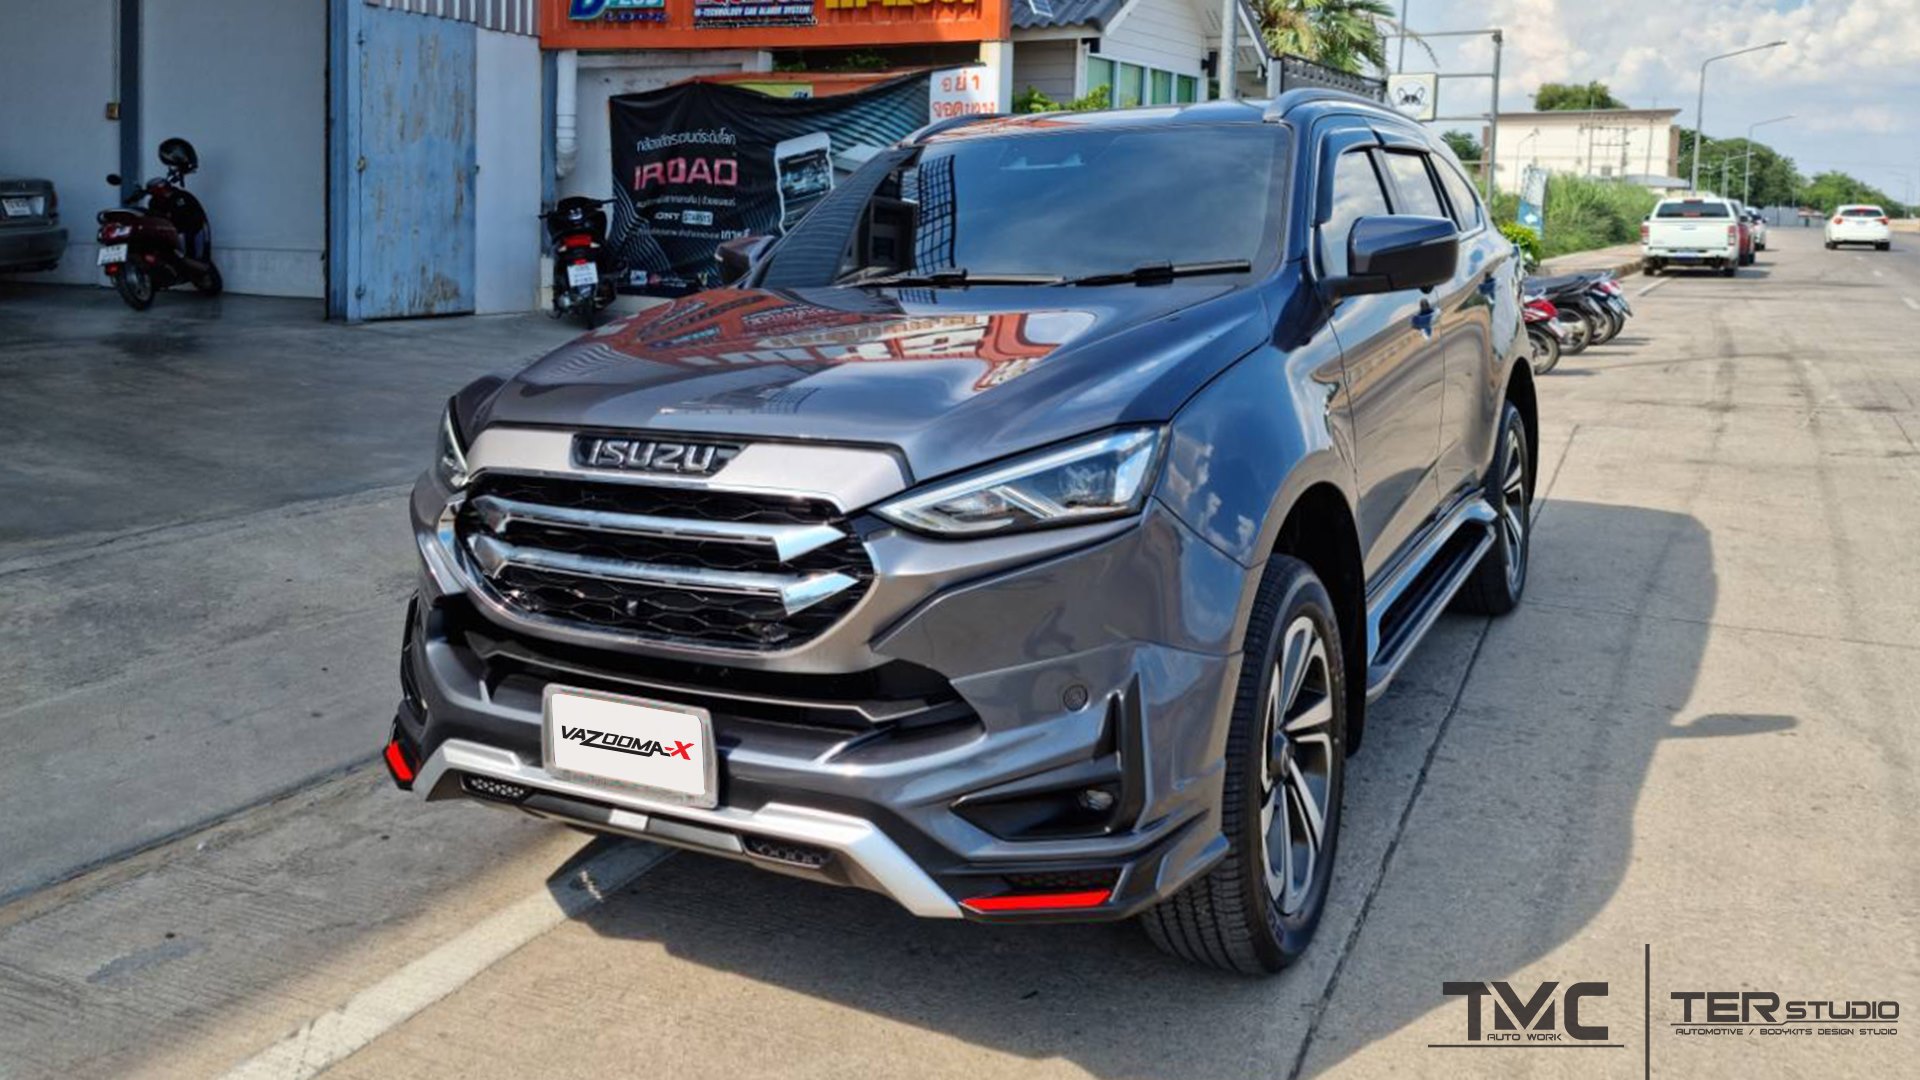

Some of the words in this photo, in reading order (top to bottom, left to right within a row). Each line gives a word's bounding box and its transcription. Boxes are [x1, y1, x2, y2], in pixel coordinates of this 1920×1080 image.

[941, 69, 980, 92] อย่า
[634, 158, 738, 190] IROAD
[587, 439, 717, 472] ISUZU
[561, 725, 695, 761] VAZOOMA-X
